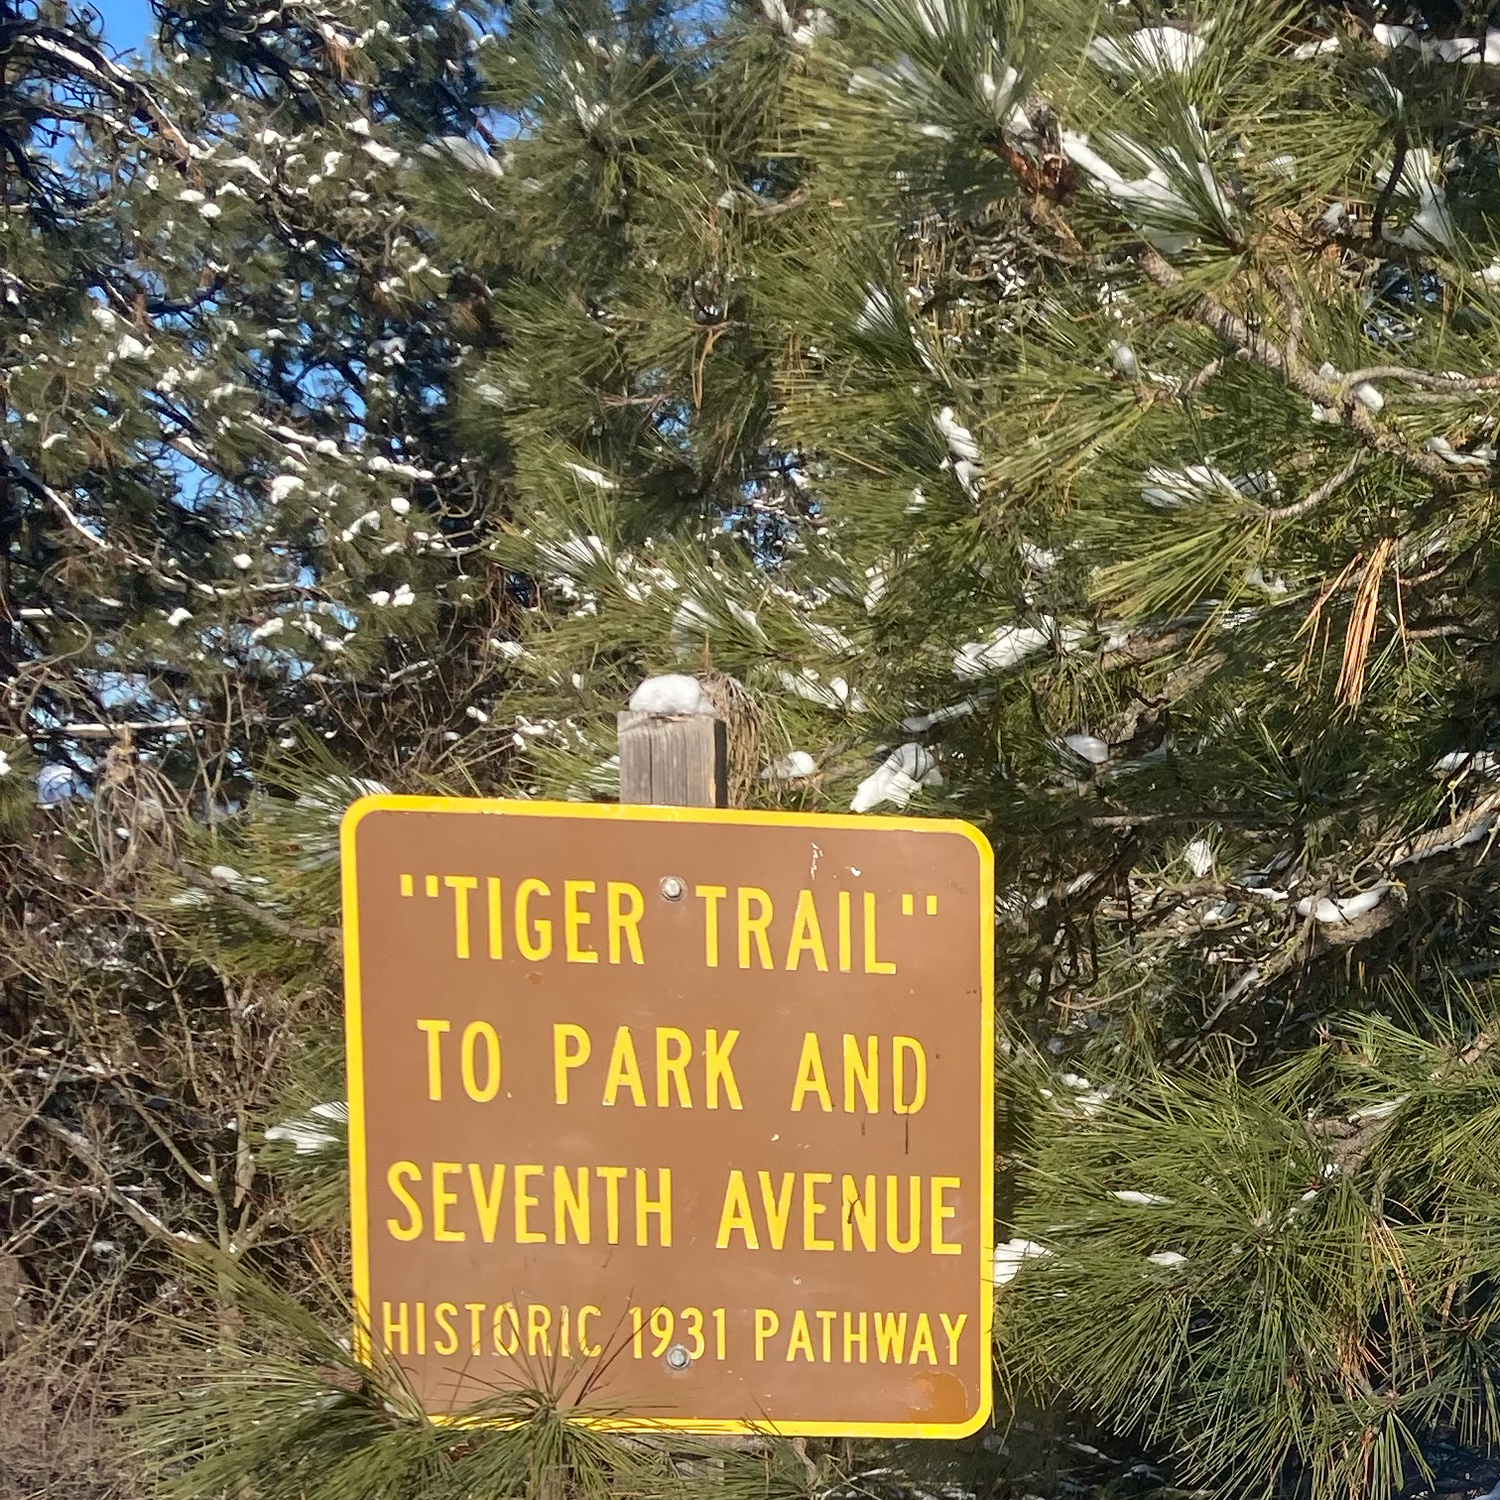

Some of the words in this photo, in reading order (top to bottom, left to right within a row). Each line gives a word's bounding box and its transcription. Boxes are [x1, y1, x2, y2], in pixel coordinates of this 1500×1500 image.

[400, 874, 645, 965] "TIGER
[696, 884, 938, 975] TRAIL"
[416, 1019, 501, 1103] TO
[553, 1023, 743, 1110] PARK
[790, 1032, 927, 1115] AND
[386, 1161, 672, 1248] SEVENTH
[716, 1170, 962, 1255] AVENUE
[383, 1301, 602, 1358] HISTORIC
[629, 1306, 726, 1361] 1931
[755, 1308, 967, 1366] PATHWAY
